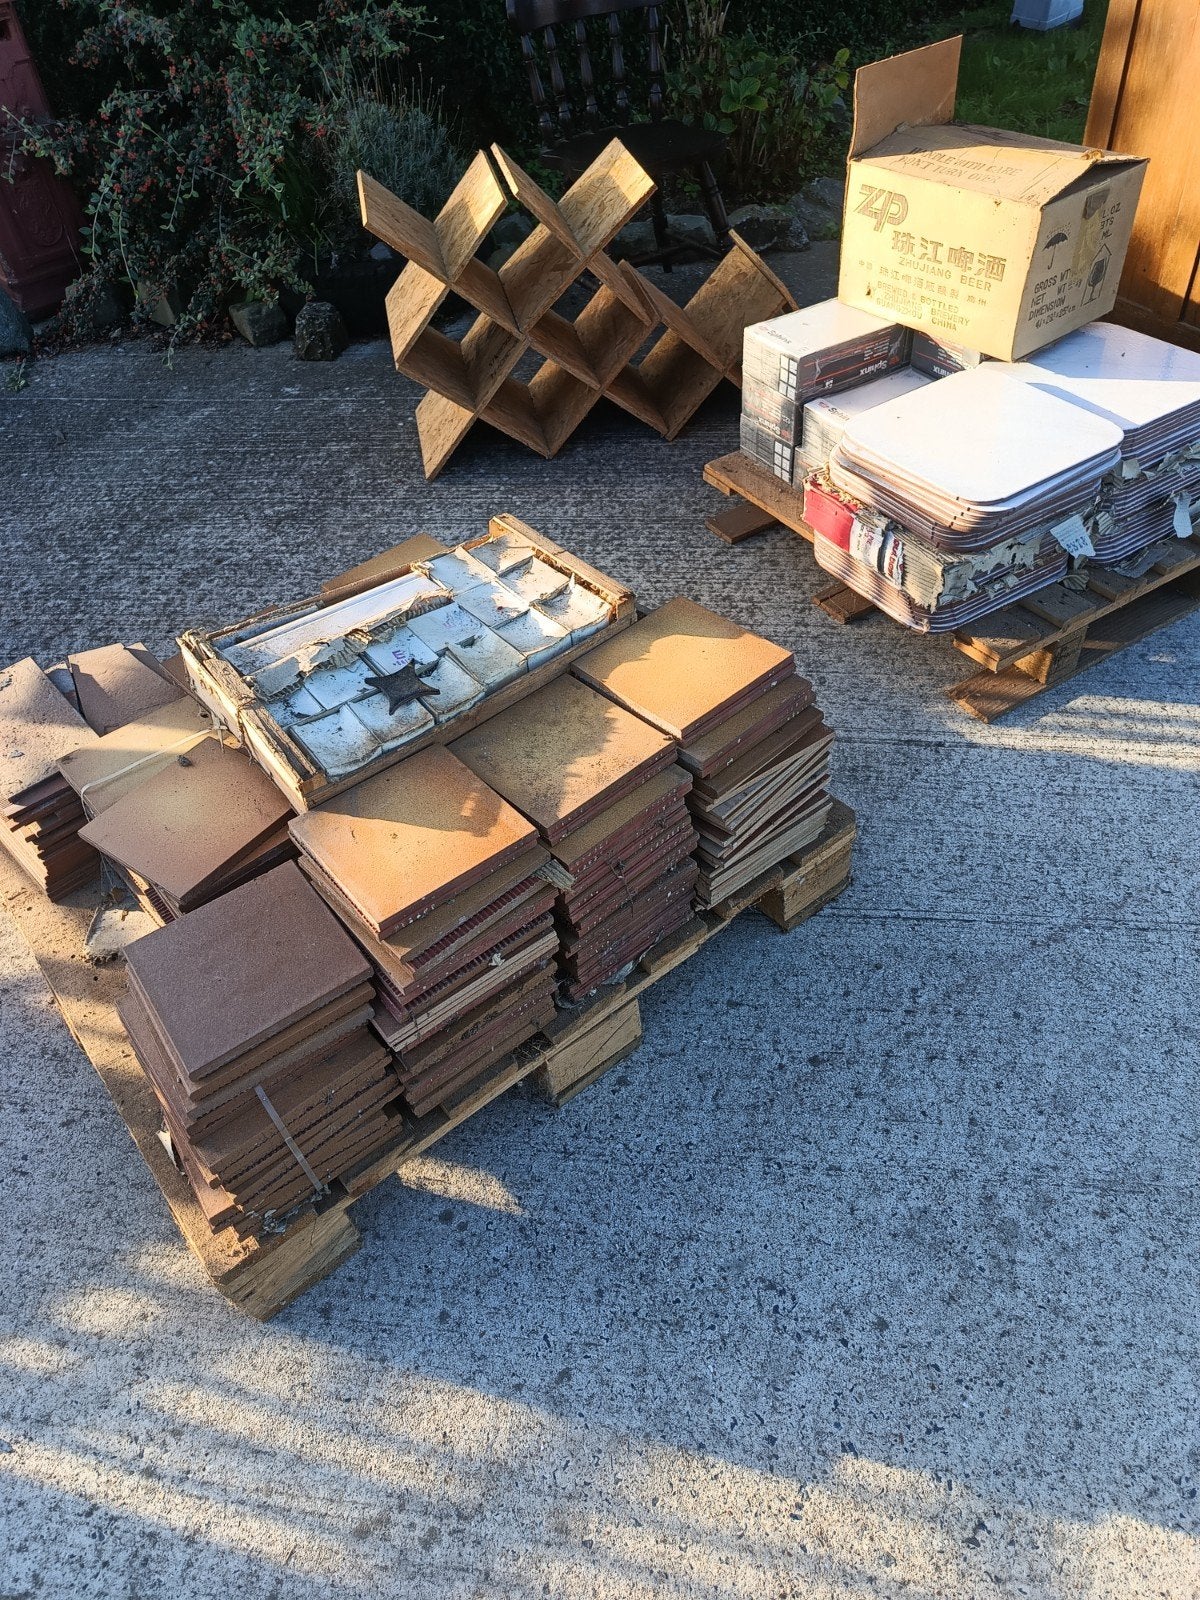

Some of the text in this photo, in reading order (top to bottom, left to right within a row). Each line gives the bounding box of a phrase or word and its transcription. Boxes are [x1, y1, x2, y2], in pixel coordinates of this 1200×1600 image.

[891, 230, 1007, 282] 珠江啤酒
[899, 256, 992, 292] ZHUJIANG BEER
[1034, 274, 1057, 294] GROSS
[877, 281, 908, 297] BREWED
[920, 295, 959, 313] BOTTLED
[1028, 295, 1066, 321] DIMENSION
[1030, 292, 1046, 308] NET
[876, 298, 957, 331] GUANGZHOU CHINA
[930, 308, 970, 326] BREWERY
[860, 360, 887, 376] Sphinx
